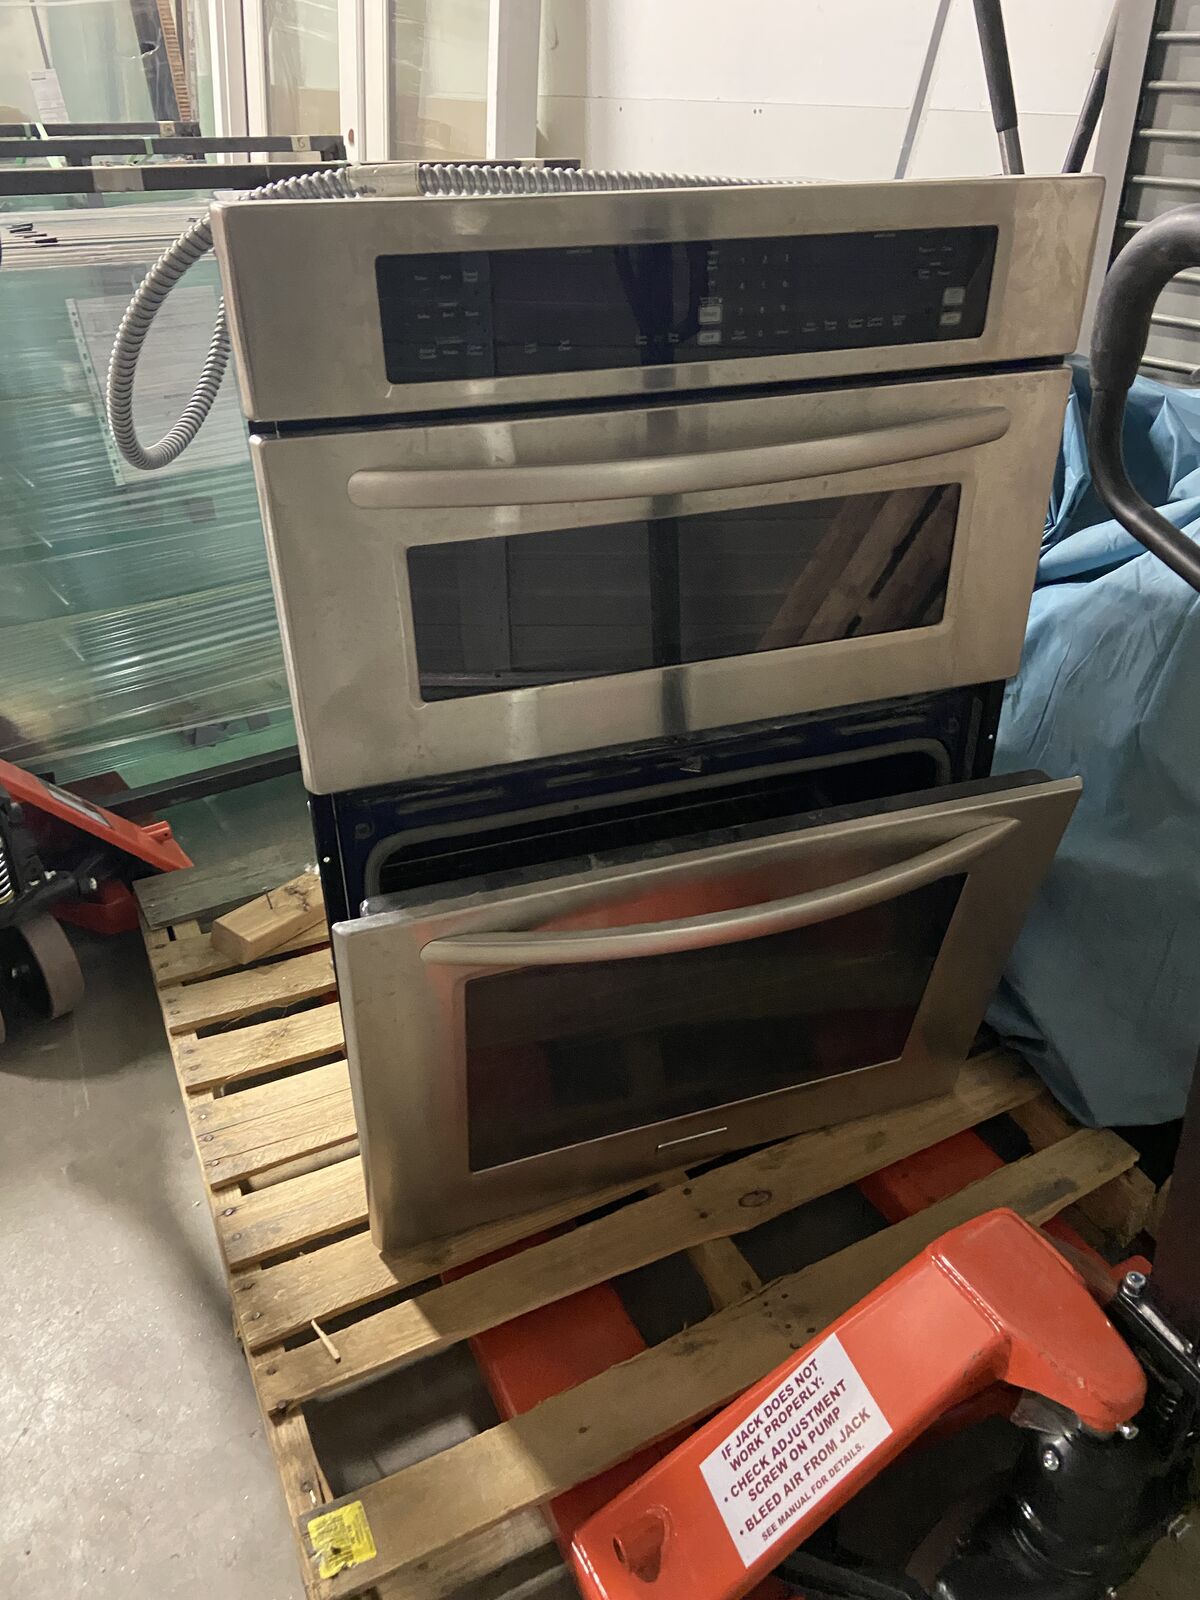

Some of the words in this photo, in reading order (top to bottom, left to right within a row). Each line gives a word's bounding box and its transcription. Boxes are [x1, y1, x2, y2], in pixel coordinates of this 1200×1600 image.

[720, 1443, 732, 1461] IF
[736, 1414, 764, 1449] JACK
[763, 1384, 794, 1418] DOES
[794, 1358, 818, 1388] NOT
[729, 1436, 765, 1471] WORK
[764, 1376, 824, 1439] PROPERLY:
[731, 1454, 770, 1497] CHECK
[771, 1379, 848, 1460] ADJUSTMENT
[748, 1458, 788, 1502] SCREW
[789, 1440, 808, 1461] ON
[808, 1406, 841, 1444] PUMP
[745, 1492, 782, 1532] BLEED
[783, 1472, 804, 1497] AIR
[803, 1438, 838, 1476] FROM
[839, 1408, 871, 1443] JACK
[762, 1522, 778, 1541] SEE
[779, 1493, 812, 1526] MANUAL
[811, 1475, 828, 1494] FOR
[828, 1444, 865, 1478] DETAILS.
